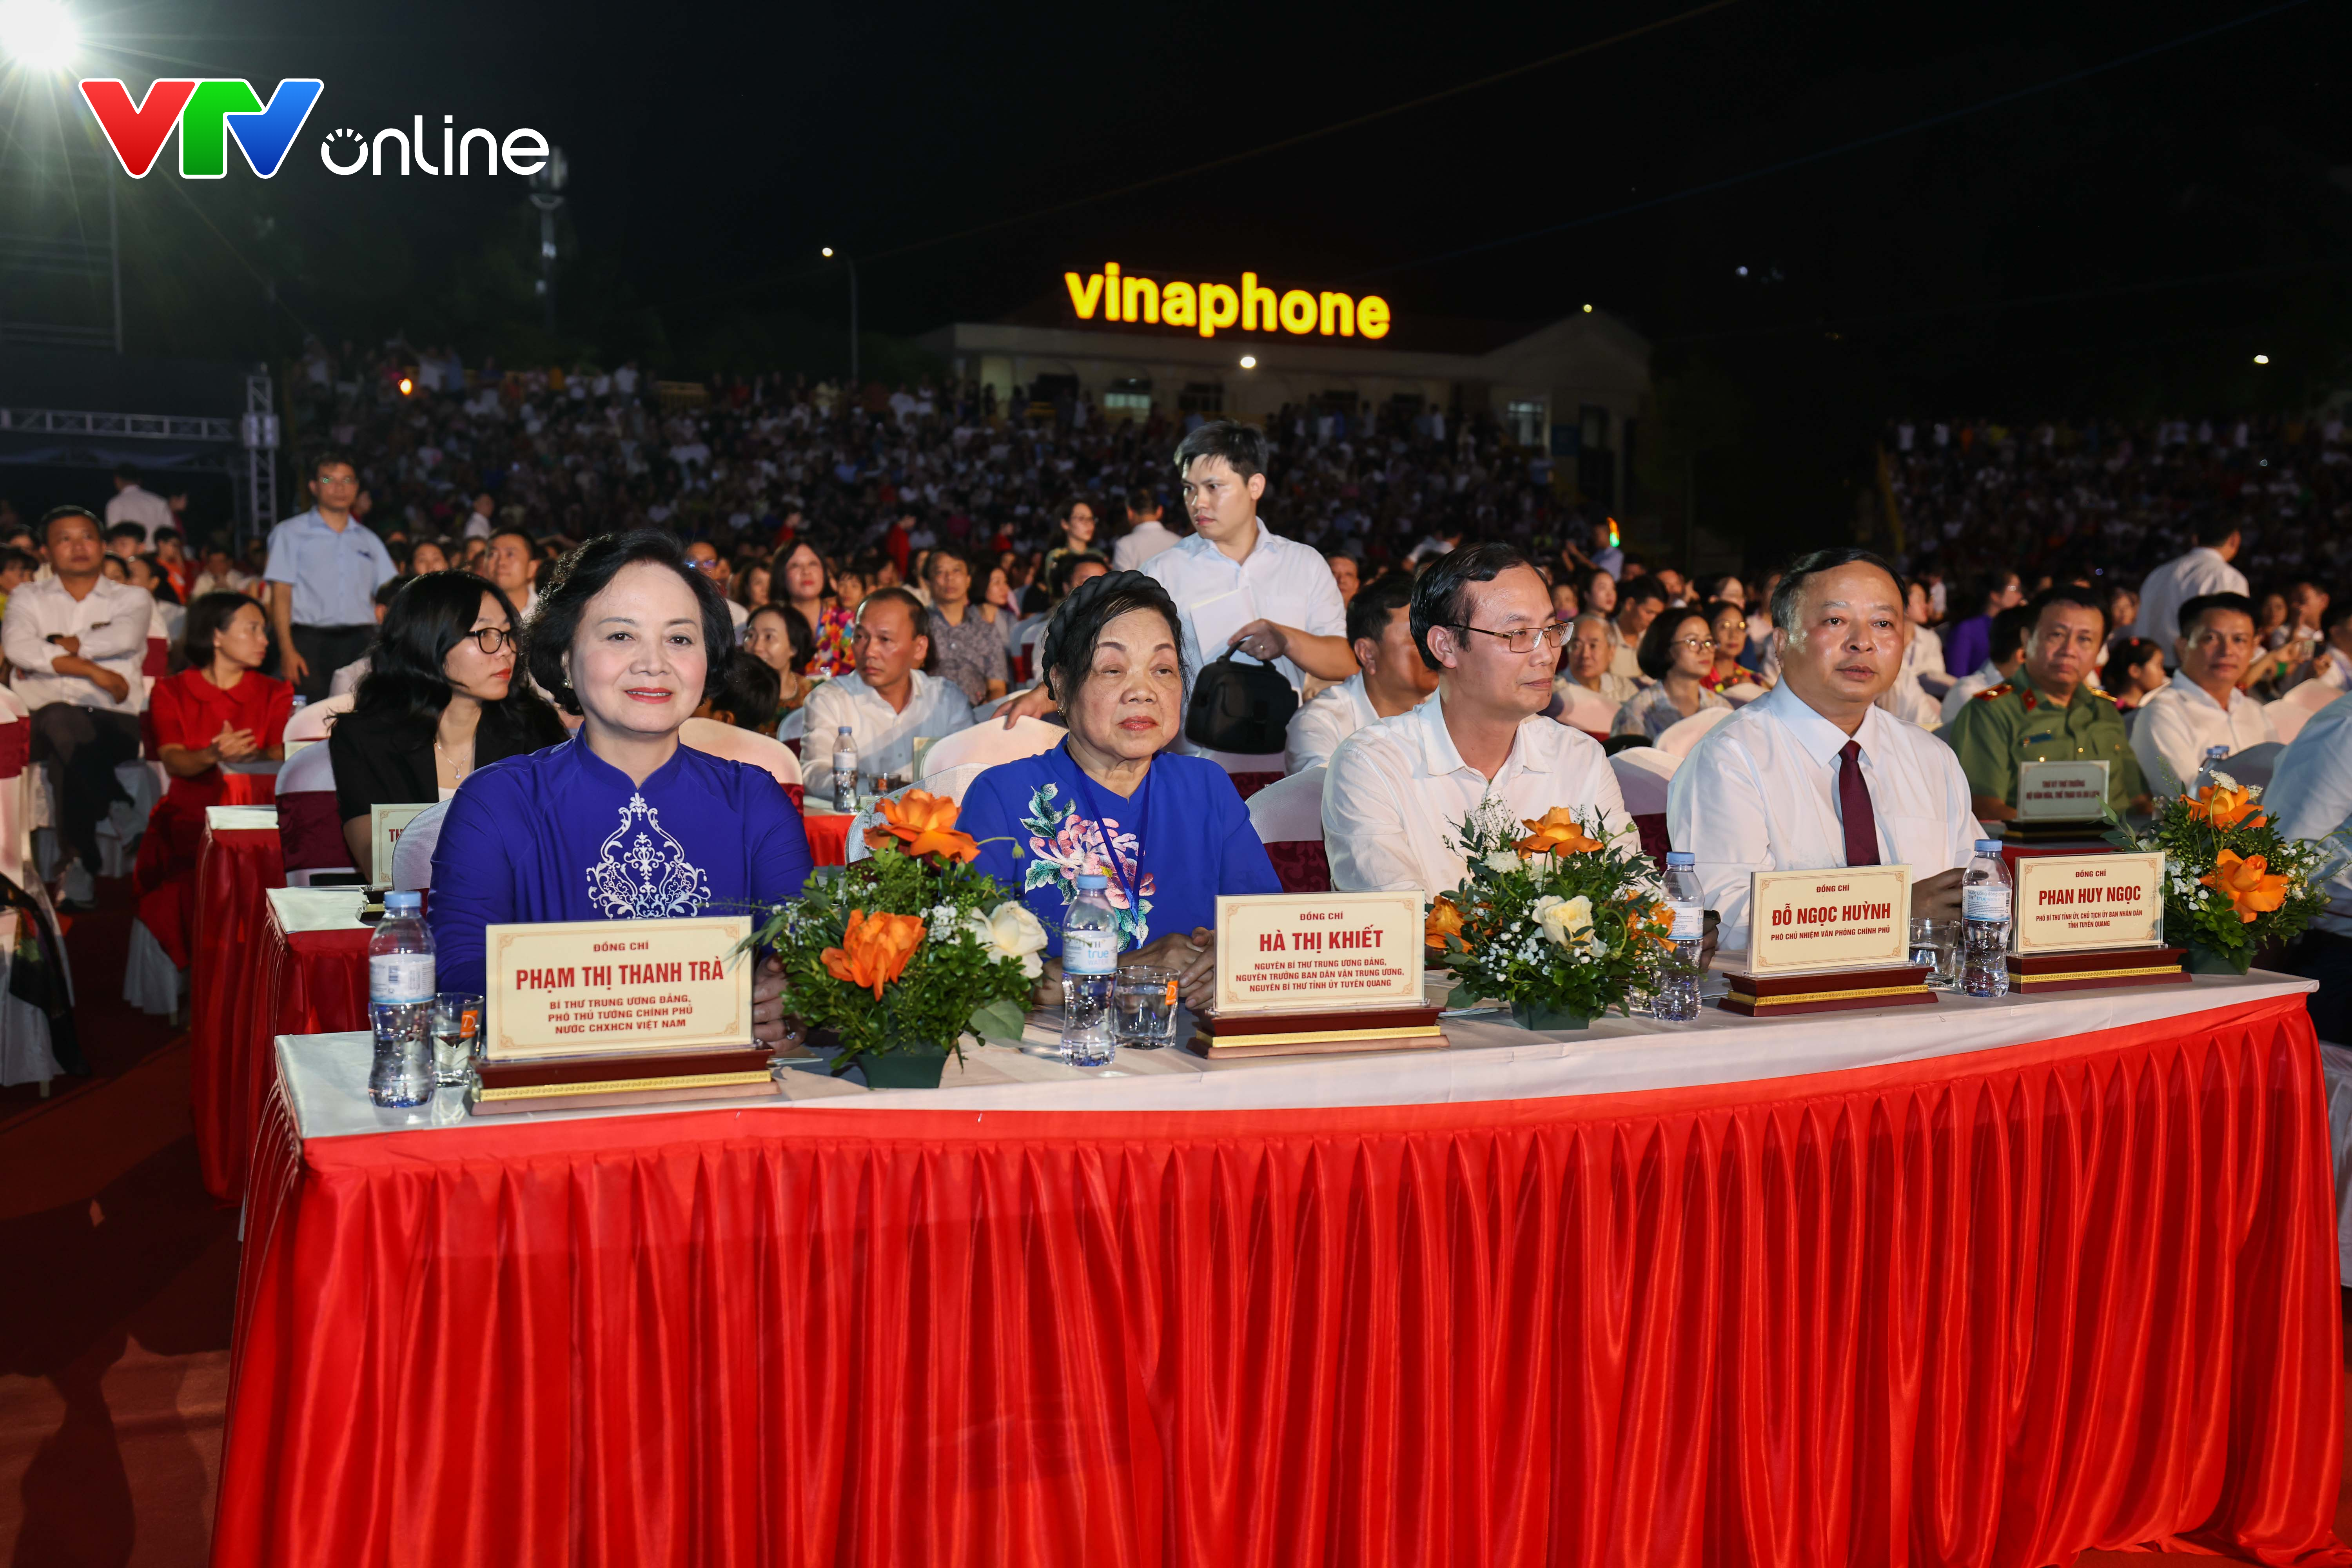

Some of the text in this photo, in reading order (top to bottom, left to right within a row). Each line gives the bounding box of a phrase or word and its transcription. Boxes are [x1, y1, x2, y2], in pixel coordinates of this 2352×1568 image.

[1063, 262, 1391, 340] vinaphone
[2039, 885, 2141, 906] PHAN HUY NGỌC
[1328, 911, 1344, 920] CHÍ
[1773, 901, 1890, 926] ĐỖ NGỌC HUỲNH
[2062, 911, 2071, 920] TỈNH
[2081, 910, 2089, 919] CHỦ
[2091, 911, 2101, 920] TỊCH
[2102, 909, 2108, 918] ỦY
[1260, 925, 1383, 953] HÀ THỊ KHIẾT
[1786, 931, 1797, 940] CHỦ
[1799, 930, 1819, 938] NHIỆM
[1821, 929, 1833, 937] VĂN
[1878, 925, 1891, 933] PHỦ
[630, 942, 649, 951] CHÍ
[1088, 949, 1109, 958] true
[1254, 961, 1285, 970] NGUYÊN
[1314, 960, 1339, 968] TRUNG
[1364, 956, 1387, 966] ĐẢNG,
[517, 956, 724, 993] PHẠM THỊ THANH TRÀ
[1236, 973, 1267, 982] NGUYÊN
[1269, 971, 1299, 980] TRƯỞNG
[1319, 970, 1336, 978] DÂN
[1338, 969, 1353, 978] VẬN
[1249, 983, 1280, 991] NGUYÊN
[1328, 978, 1338, 989] ỦY
[1340, 980, 1365, 988] TUYÊN
[1367, 979, 1392, 987] QUANG
[550, 992, 691, 1010] BÍ THƯ TRUNG ƯƠNG ĐẢNG,
[548, 1004, 693, 1022] PHÓ THỦ TƯỚNG CHÍNH PHỦ
[555, 1018, 686, 1034] NƯỚC CHXHCN VIỆT NAM
